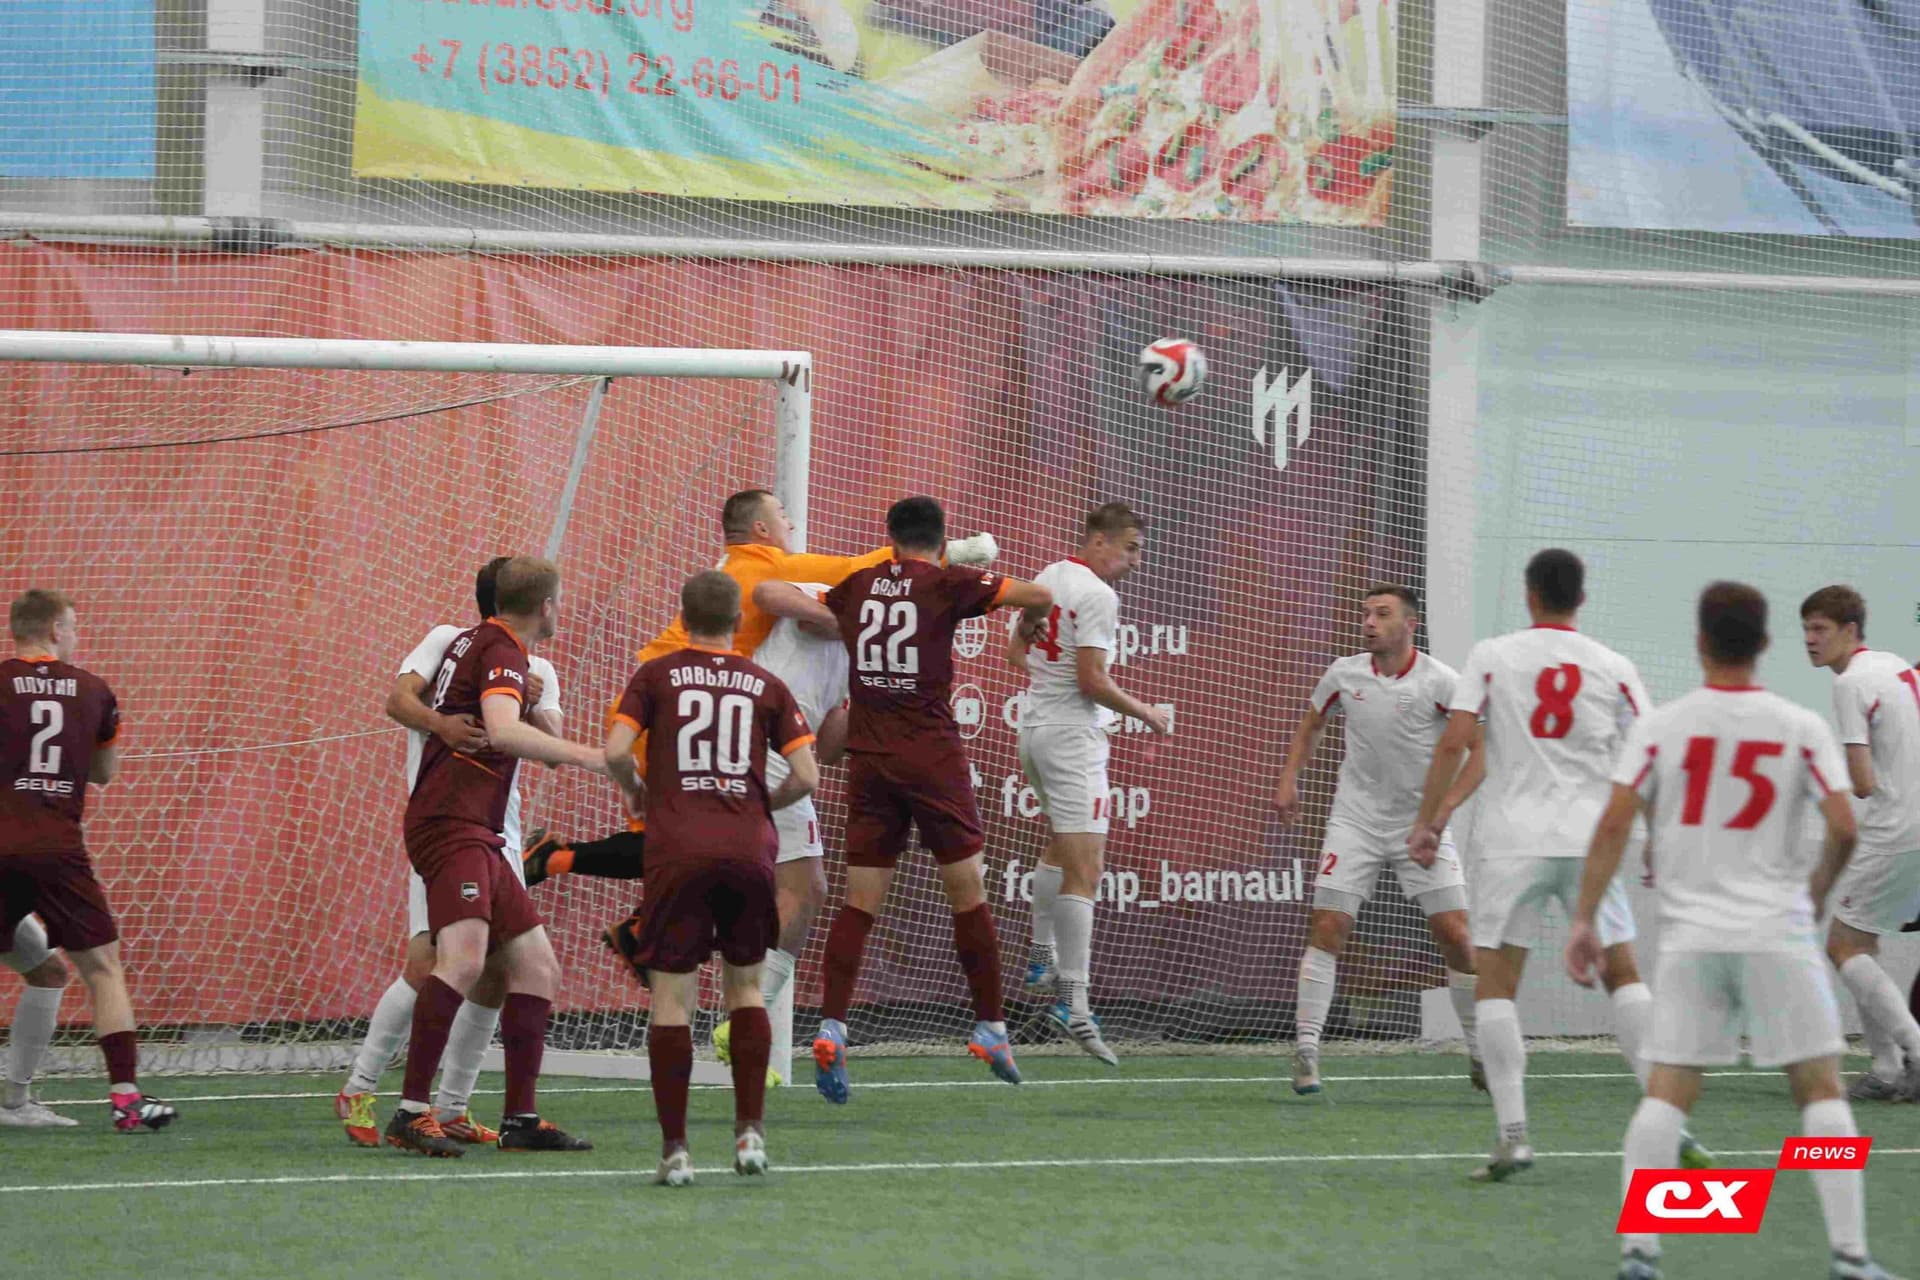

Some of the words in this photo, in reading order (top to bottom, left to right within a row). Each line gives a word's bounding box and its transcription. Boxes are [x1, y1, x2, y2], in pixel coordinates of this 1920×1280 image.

[411, 39, 463, 81] +7
[478, 41, 609, 98] (3852)
[627, 52, 801, 104] 22-66-01
[857, 599, 919, 674] 22
[669, 666, 765, 697] ЗАВЬЯЛОВ
[1529, 662, 1582, 739] 8
[29, 700, 64, 774] 2
[677, 689, 754, 775] 20
[1680, 736, 1784, 830] 15
